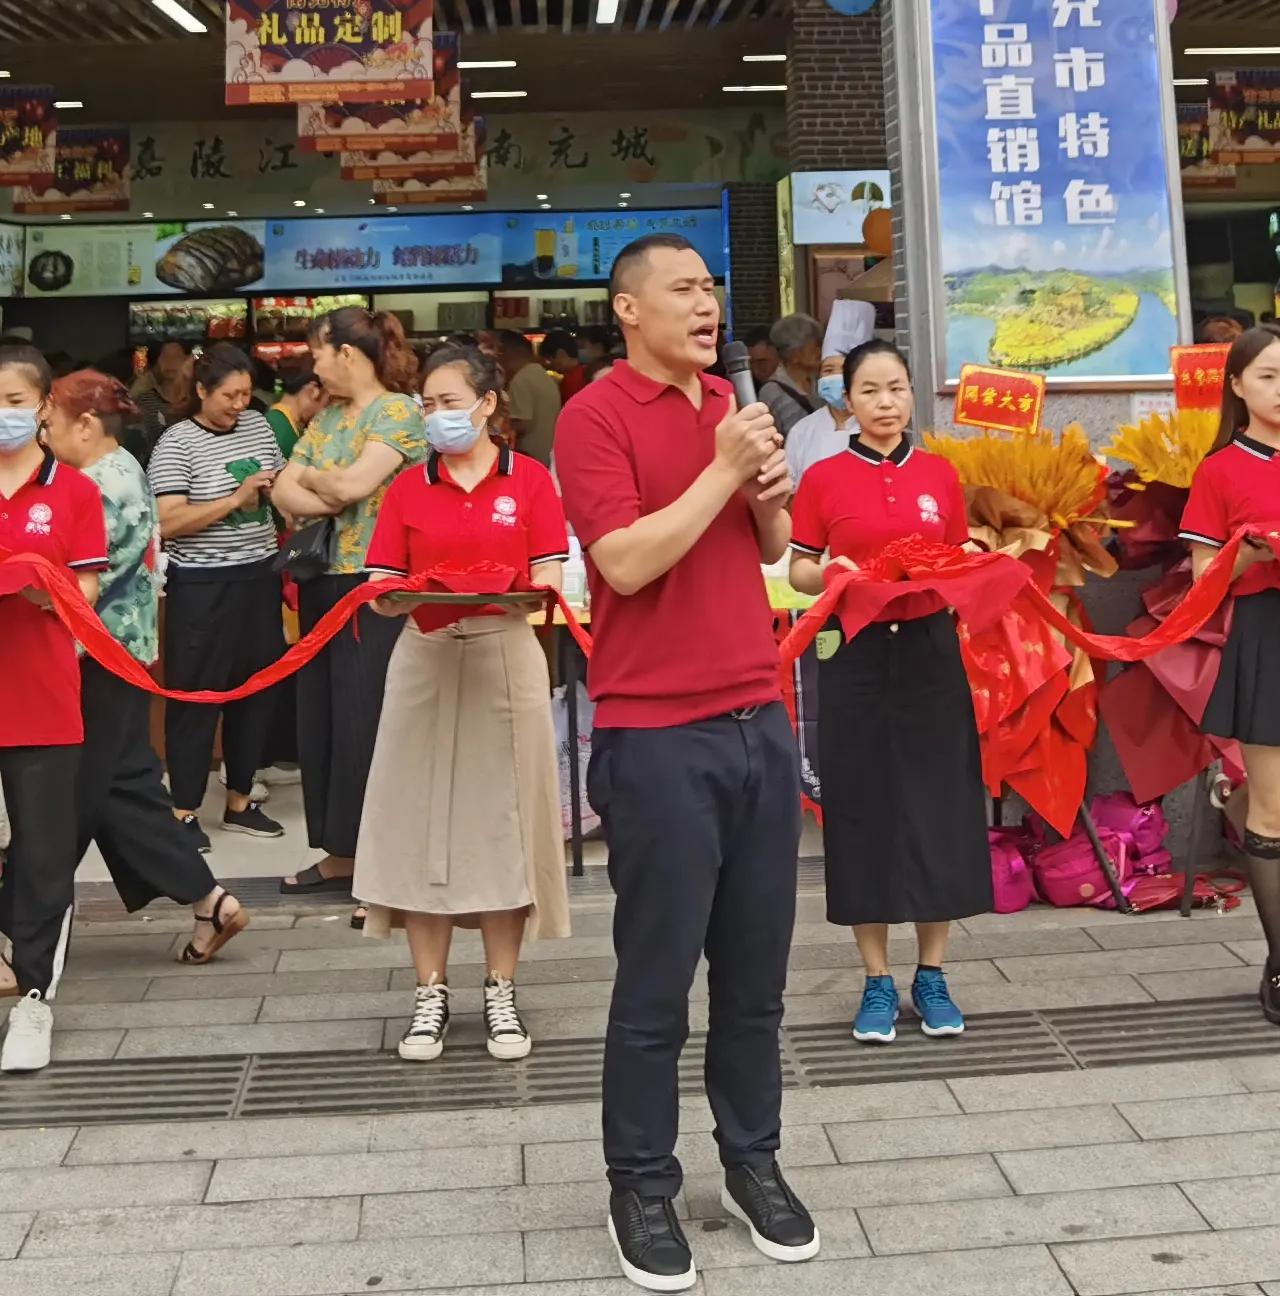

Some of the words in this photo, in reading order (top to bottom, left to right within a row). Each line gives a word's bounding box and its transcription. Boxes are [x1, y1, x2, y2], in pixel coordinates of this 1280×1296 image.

[258, 10, 403, 46] 礼品定制
[486, 125, 657, 170] 南充城
